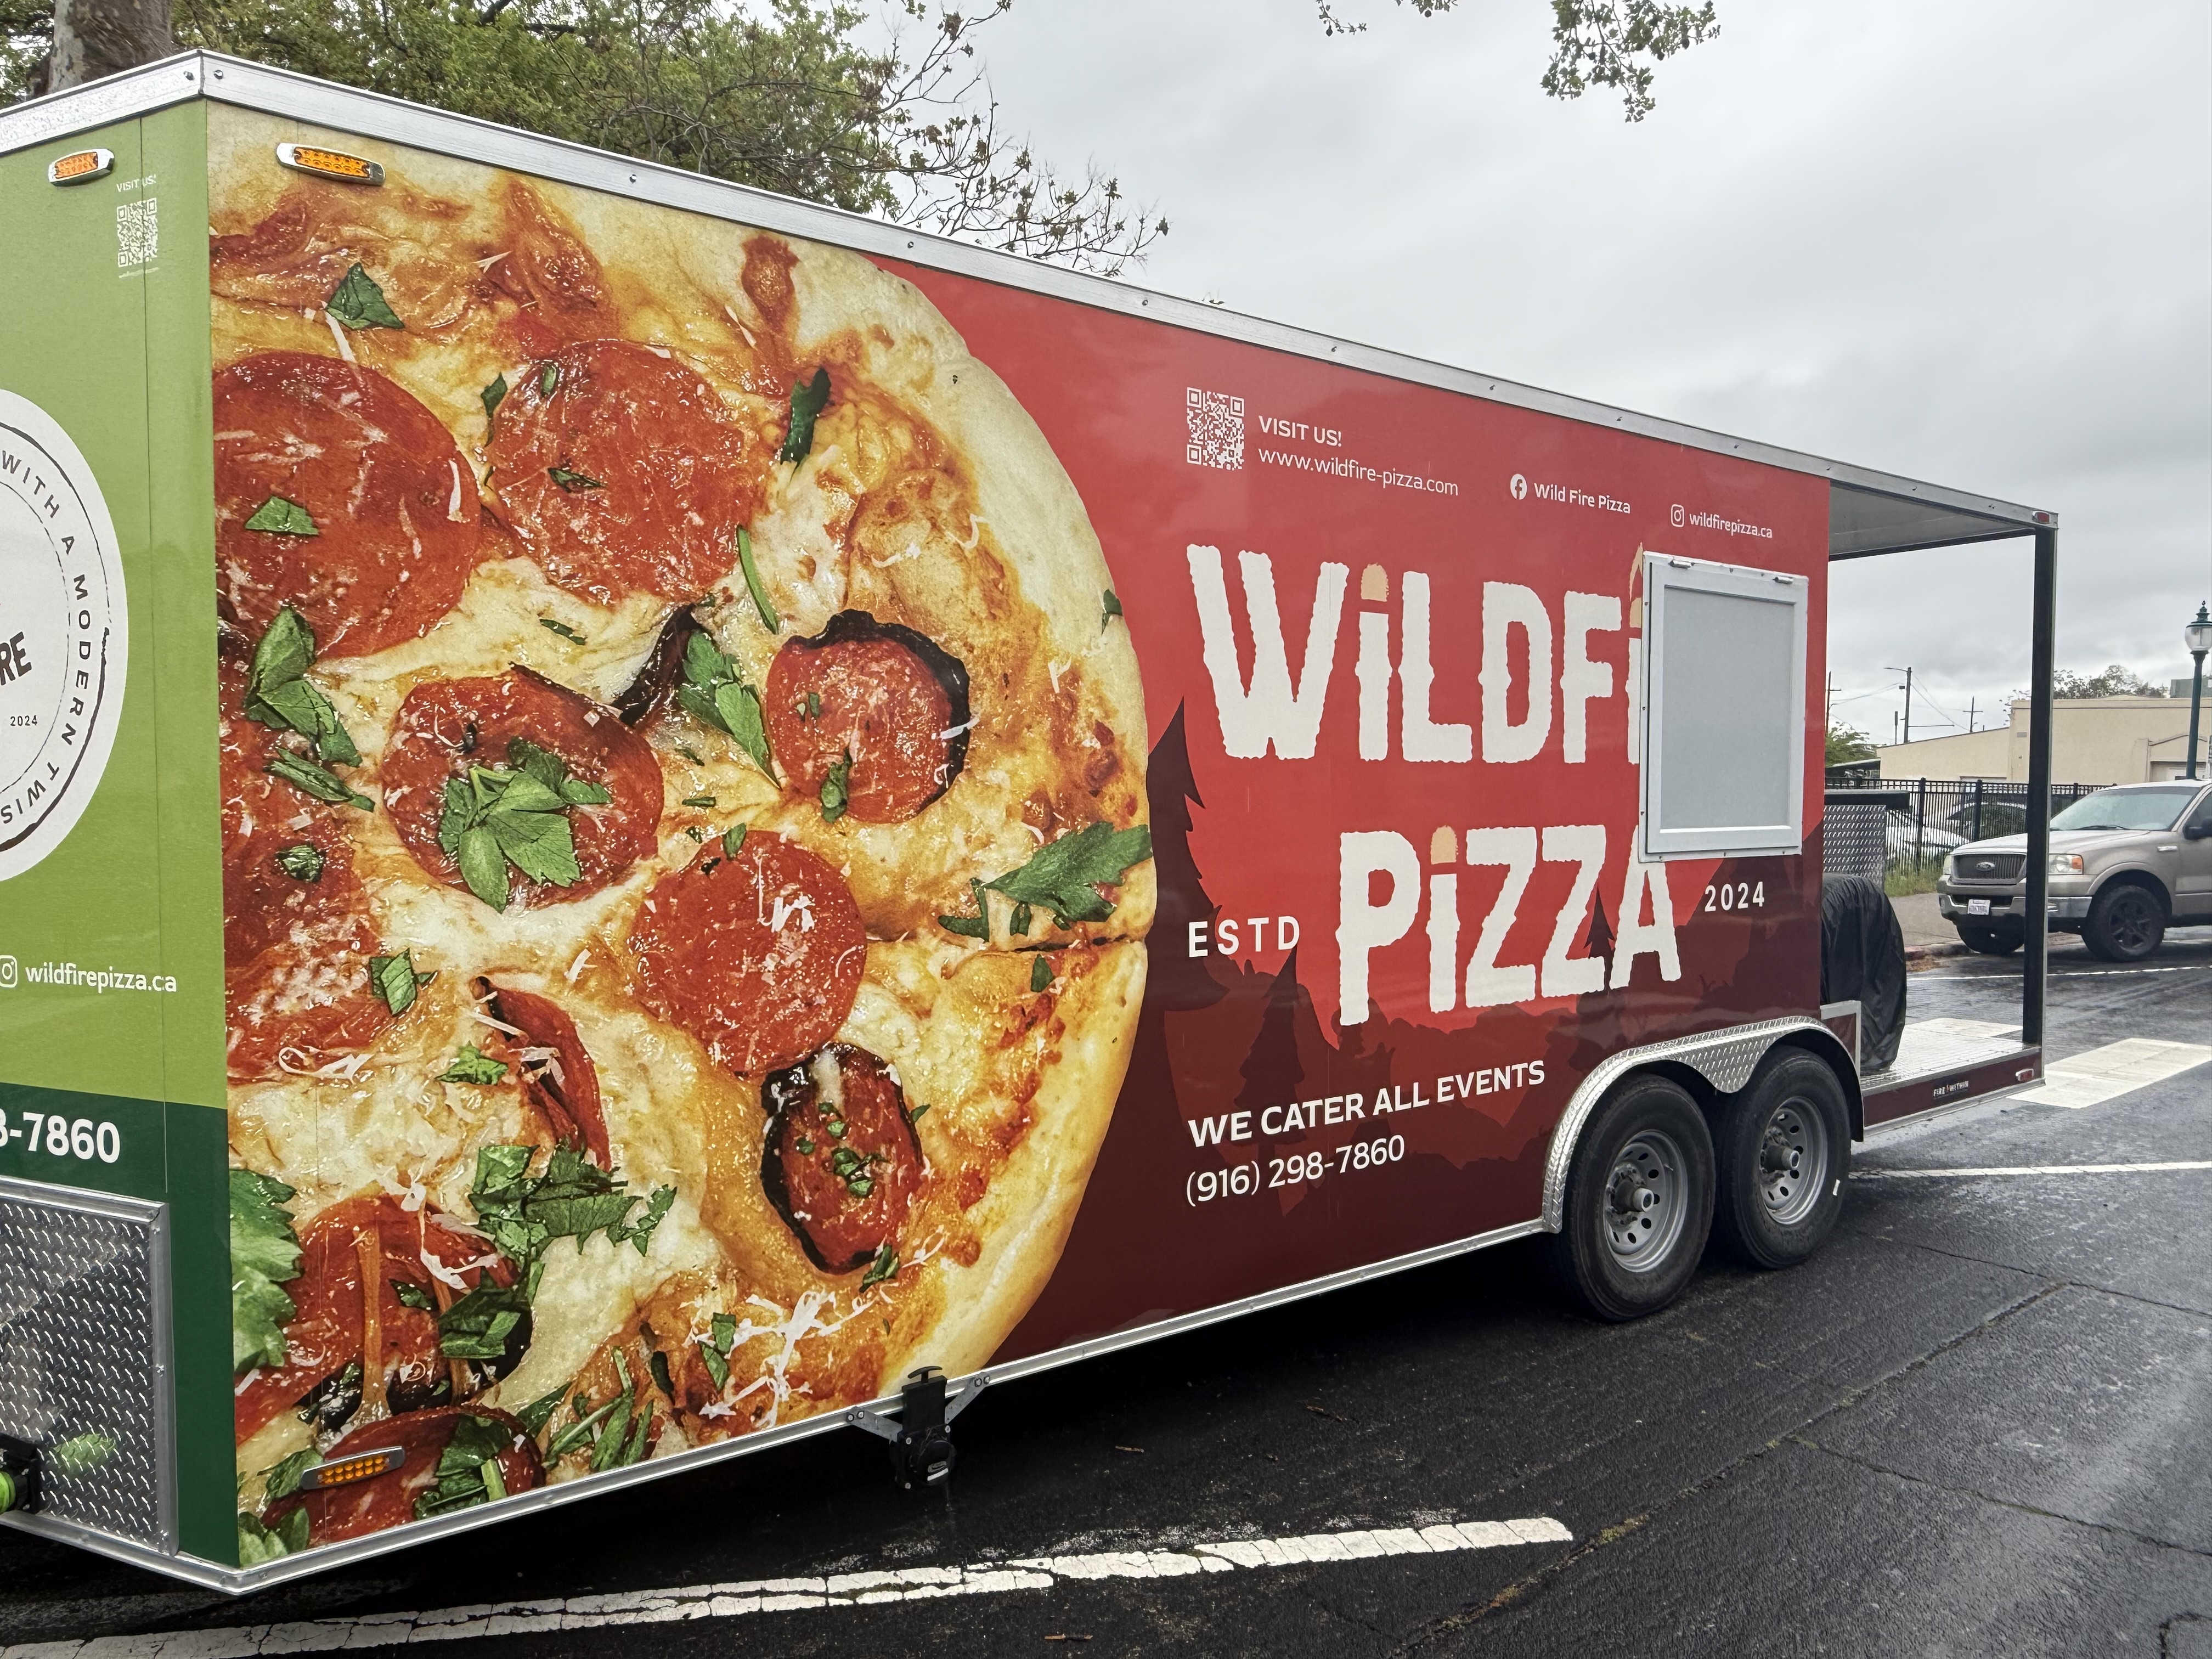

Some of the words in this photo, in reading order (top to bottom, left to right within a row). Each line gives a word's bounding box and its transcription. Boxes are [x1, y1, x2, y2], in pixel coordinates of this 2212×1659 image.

[116, 179, 140, 193] VISIT
[1259, 415, 1309, 440] VISIT
[1313, 426, 1342, 447] US!
[2, 450, 60, 518] WITH
[1258, 448, 1458, 496] www.wildfire-pizza.com
[1533, 482, 1566, 502] Wild
[1569, 489, 1595, 507] Fire
[1598, 495, 1630, 514] Pizza
[1689, 512, 1773, 539] wildfirepizza.ca
[61, 536, 75, 555] A
[60, 574, 92, 746] MODERN
[10, 715, 38, 727] 2024
[1705, 881, 1765, 912] 2024
[1188, 916, 1300, 958] ESTD
[25, 961, 177, 994] wildfirepizza.ca
[1188, 1110, 1252, 1148] WE
[1261, 1093, 1366, 1135] CATER
[1372, 1082, 1430, 1116] ALL
[1437, 1060, 1545, 1103] EVENTS
[1186, 1161, 1261, 1207] (916)
[1268, 1135, 1406, 1188] 298-7860
